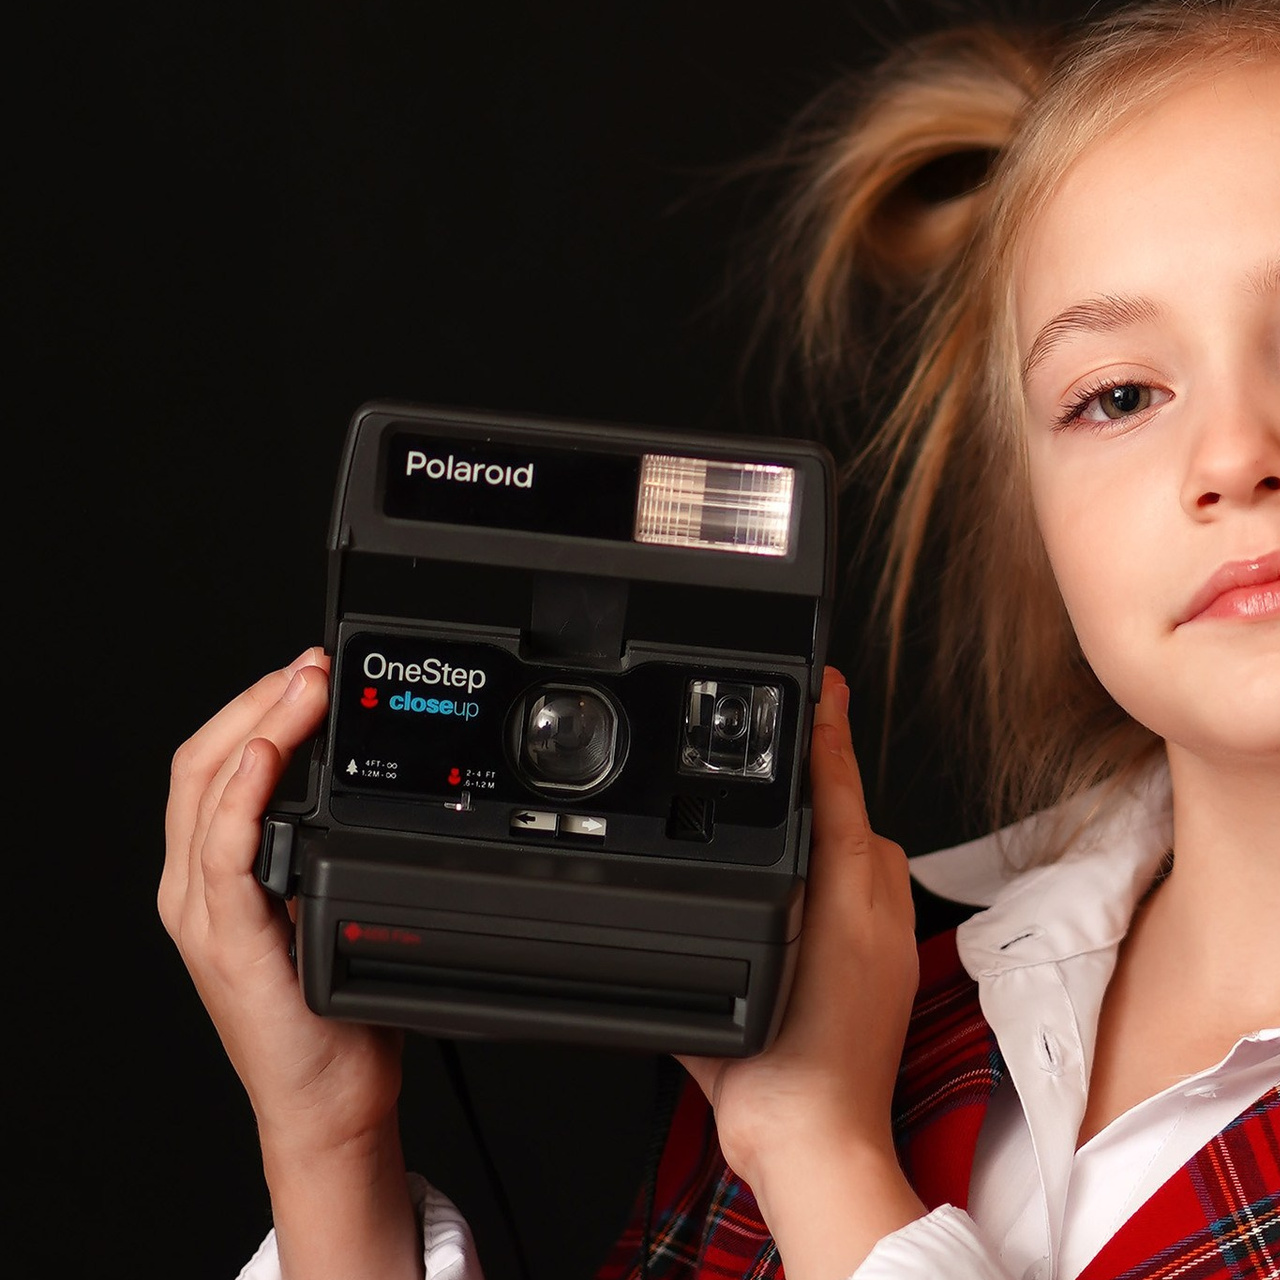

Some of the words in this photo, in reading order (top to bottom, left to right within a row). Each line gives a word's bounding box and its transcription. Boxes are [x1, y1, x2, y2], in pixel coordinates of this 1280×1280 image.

[406, 450, 534, 489] Polaroid
[363, 652, 487, 694] OneStep
[389, 690, 480, 722] closeup
